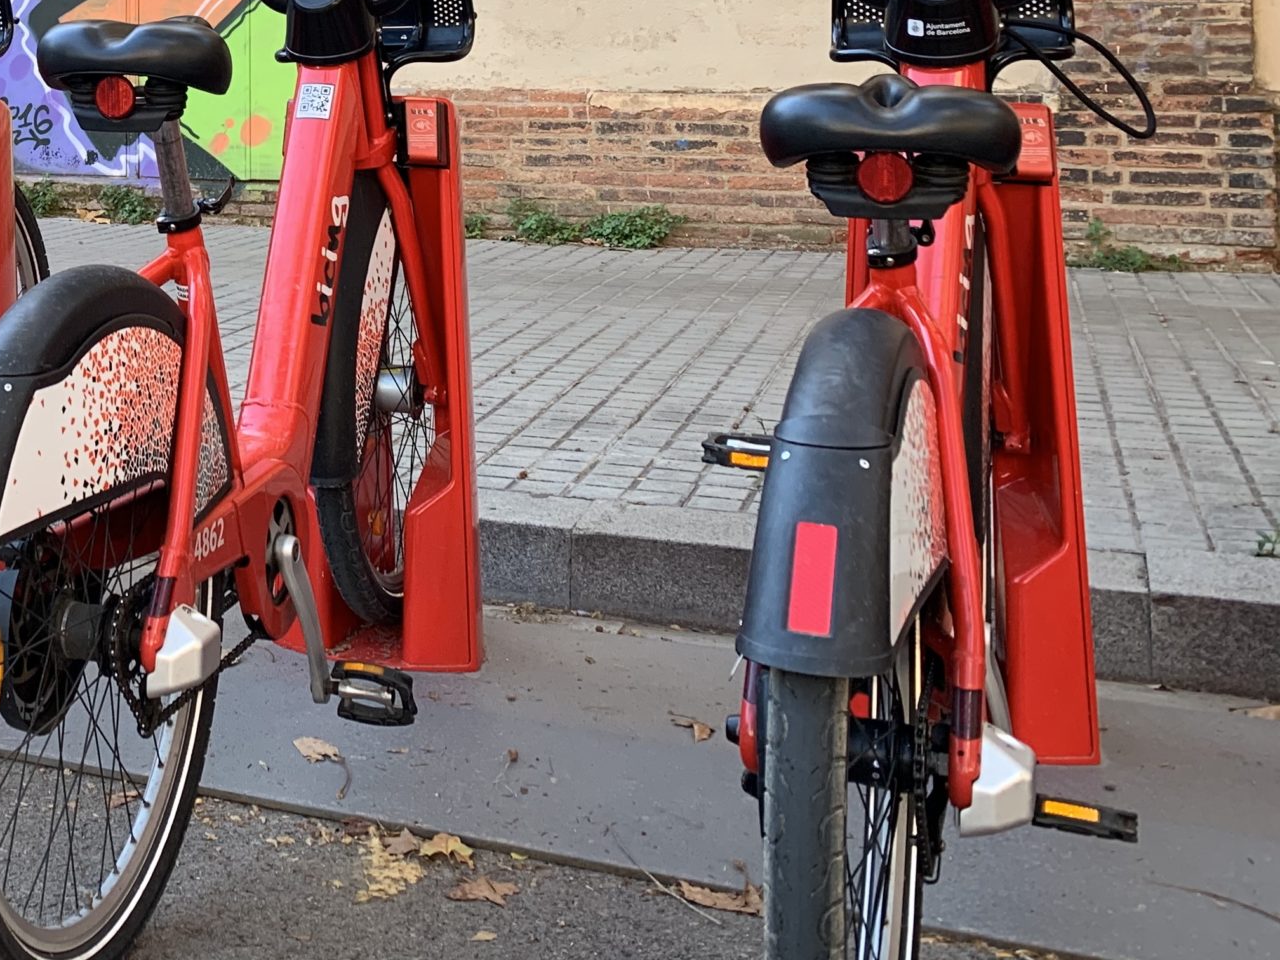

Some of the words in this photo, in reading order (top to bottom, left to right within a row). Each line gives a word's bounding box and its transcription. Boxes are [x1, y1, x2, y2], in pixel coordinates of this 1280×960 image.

[926, 21, 966, 31] Ajuntament
[936, 27, 971, 36] Barcelona
[310, 195, 350, 326] bicing
[194, 517, 225, 562] 4862
